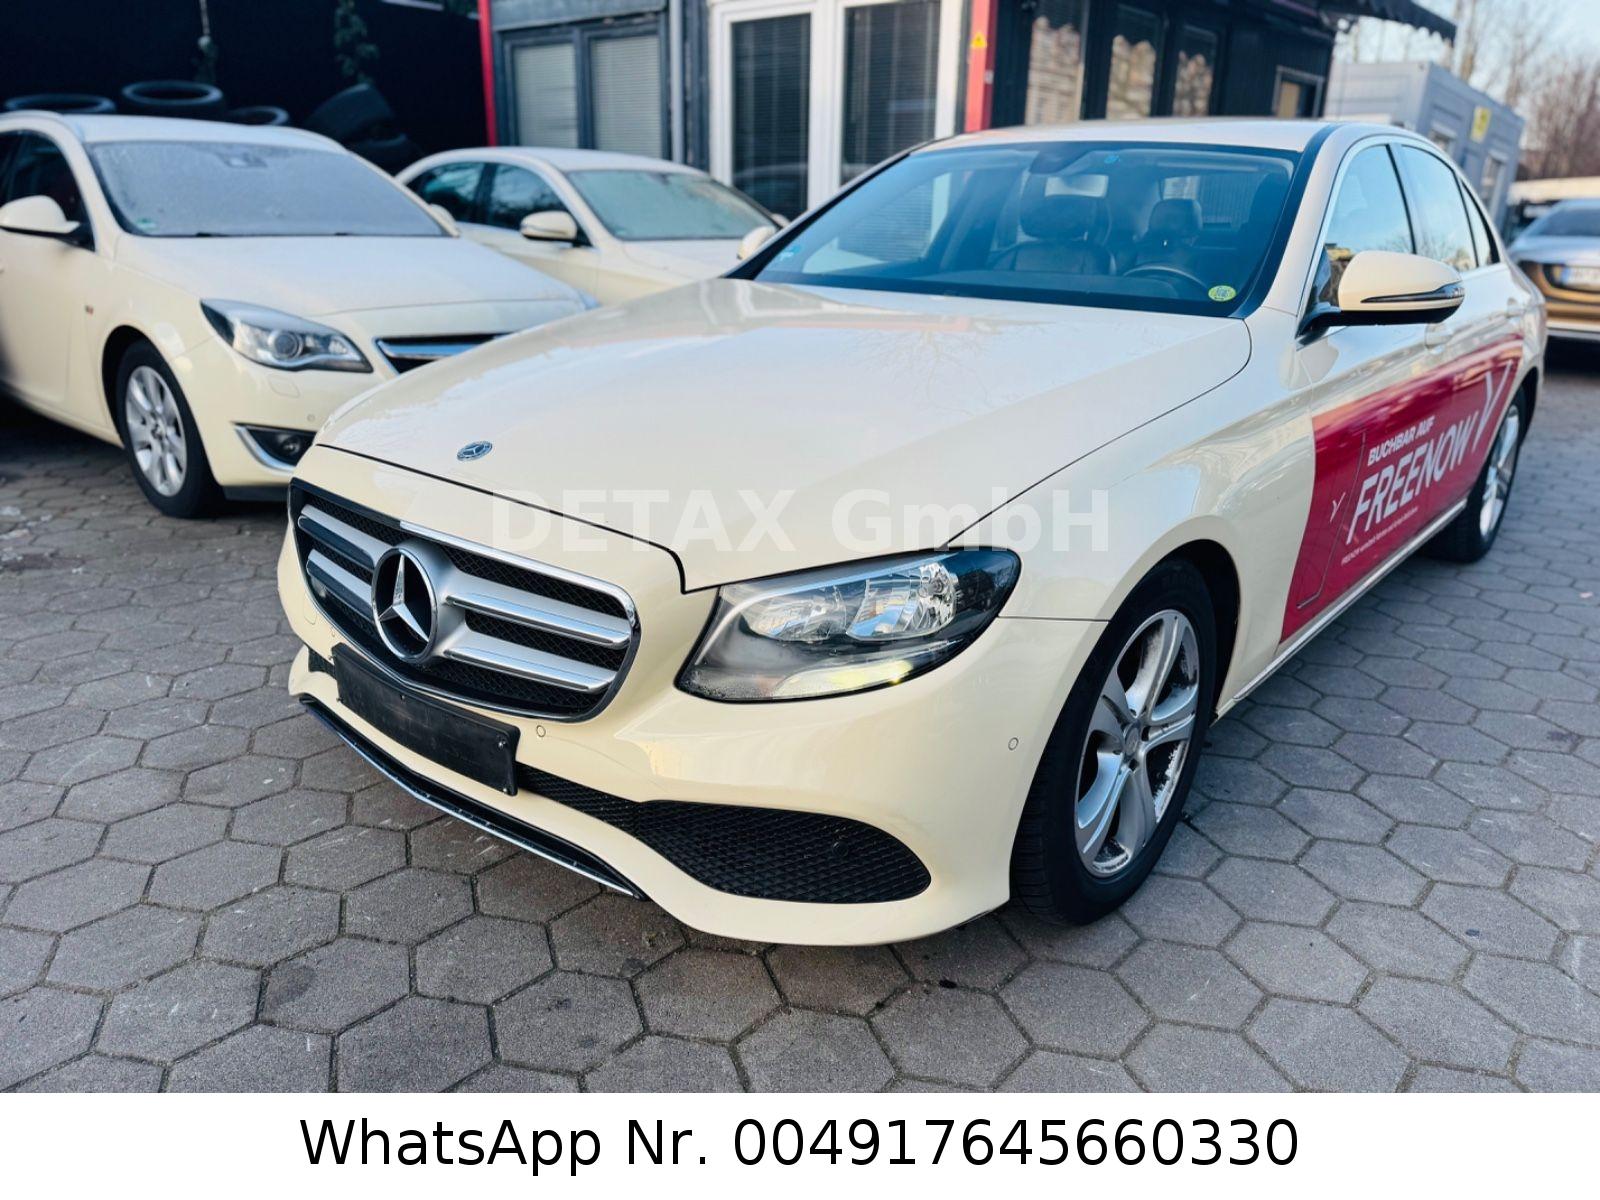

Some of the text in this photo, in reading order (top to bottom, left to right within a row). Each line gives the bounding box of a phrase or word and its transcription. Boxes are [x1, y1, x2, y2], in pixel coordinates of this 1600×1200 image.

[1346, 410, 1479, 546] FREENOW
[1367, 415, 1436, 467] BUCHBAR AUF
